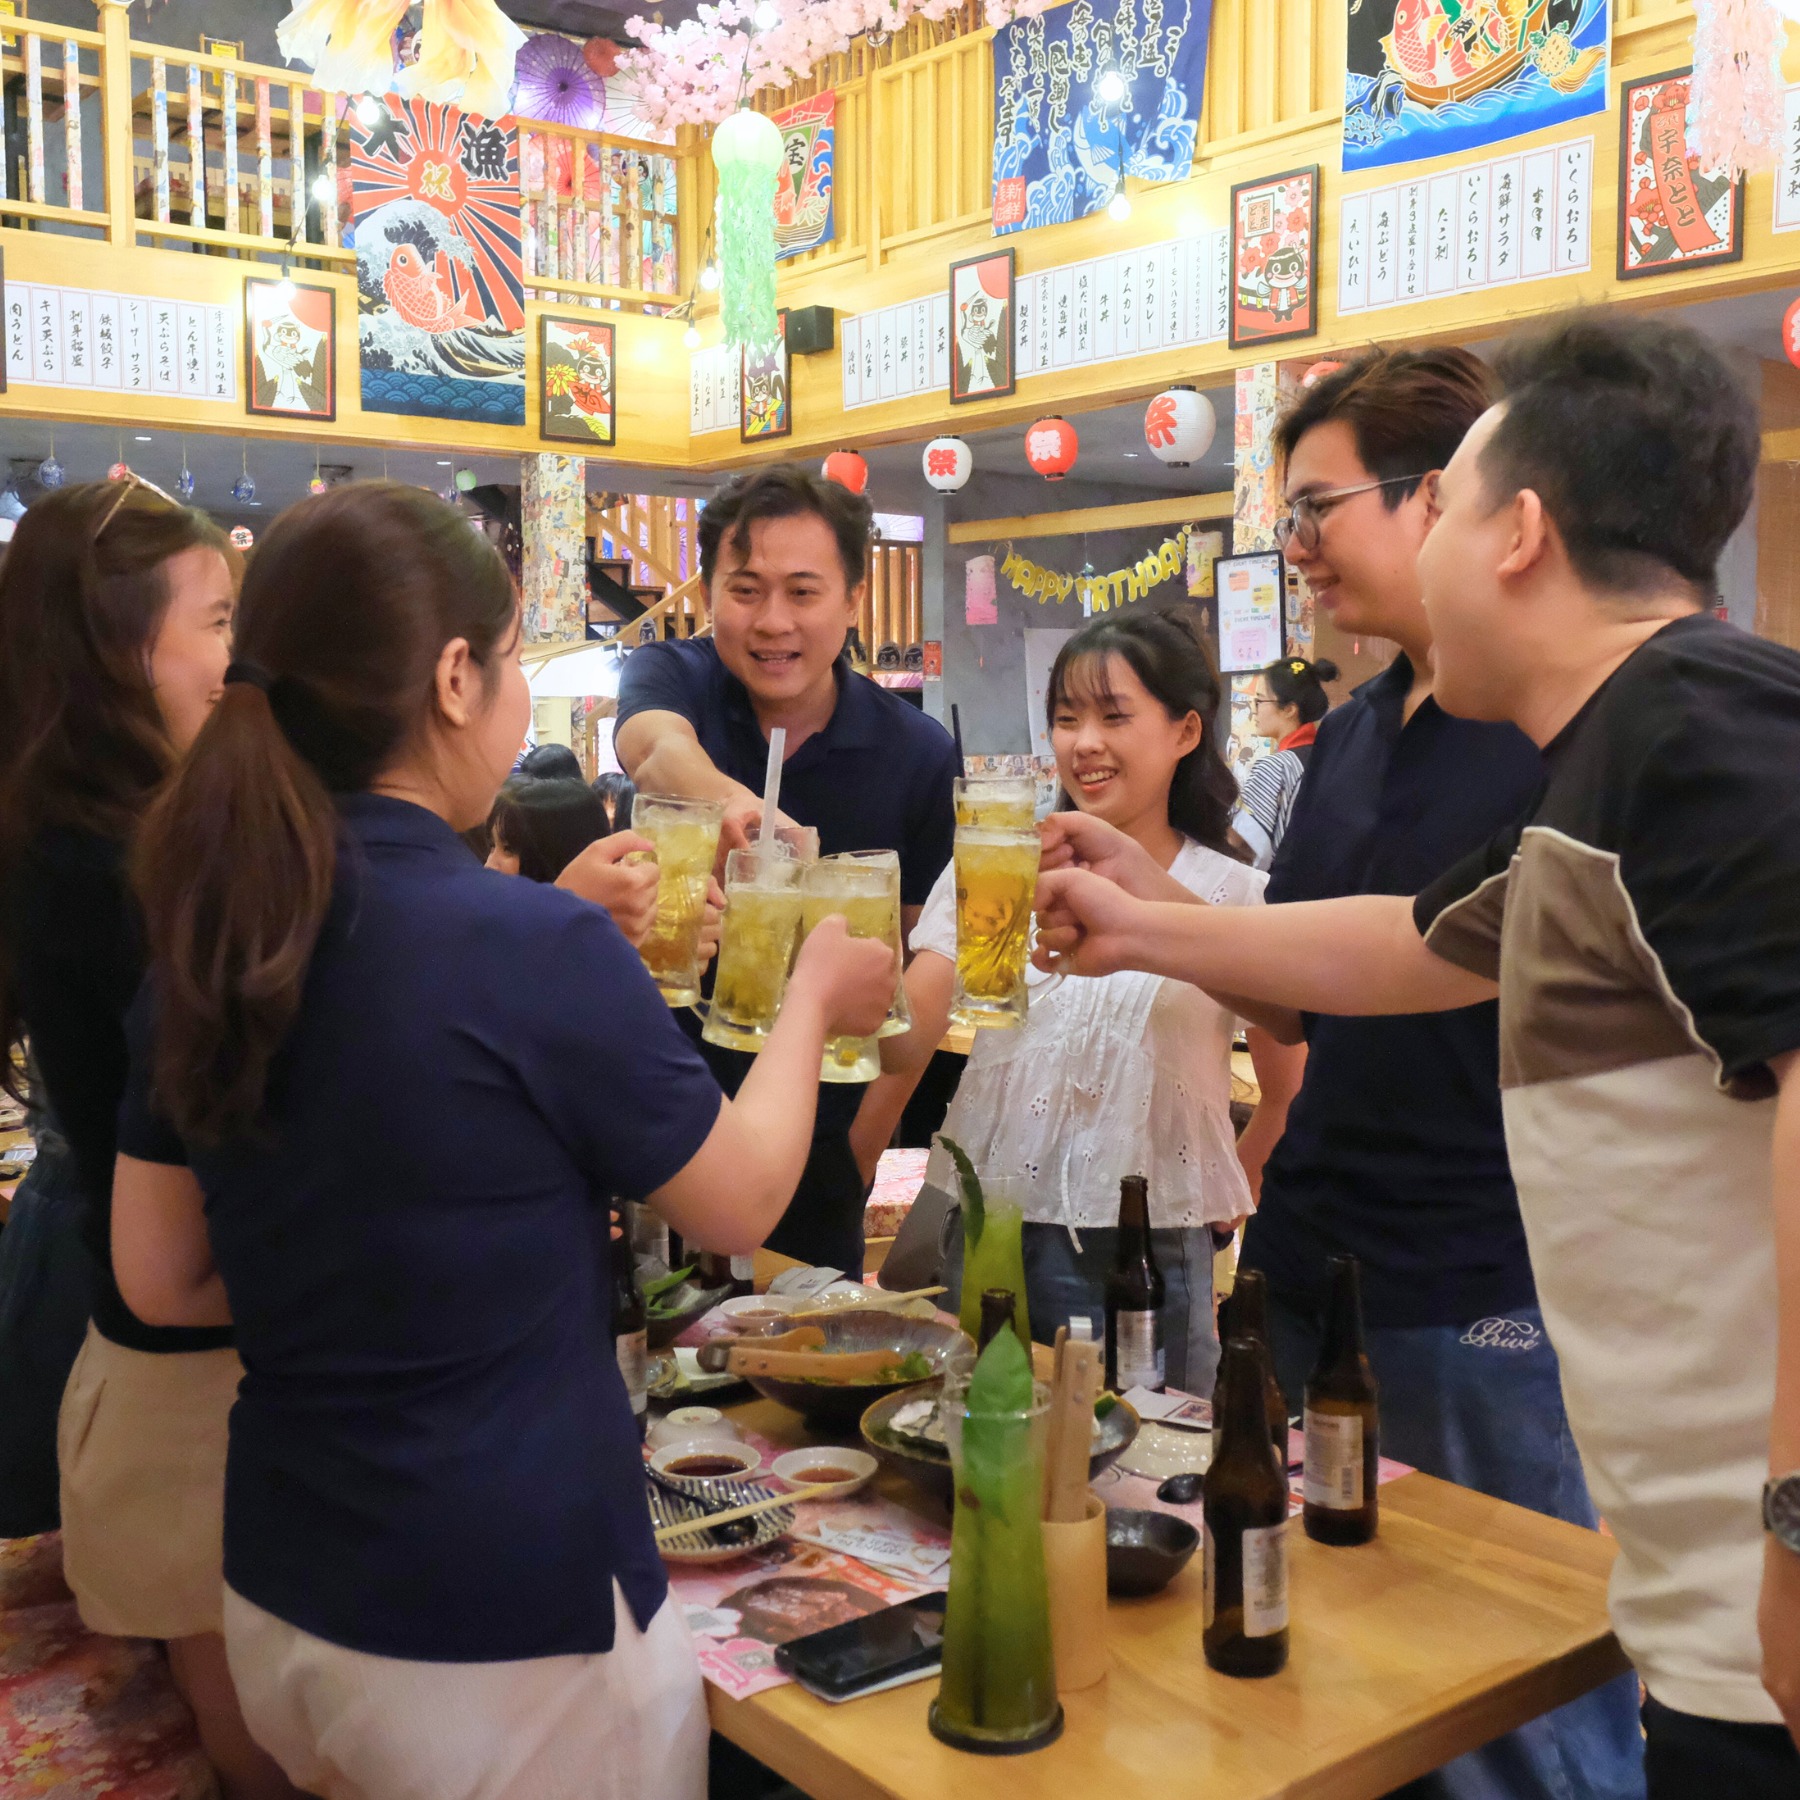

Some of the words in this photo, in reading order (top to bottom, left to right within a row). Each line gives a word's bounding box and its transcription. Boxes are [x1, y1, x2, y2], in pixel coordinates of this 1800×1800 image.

[419, 160, 456, 201] 祝
[785, 138, 806, 166] 宝
[1657, 128, 1697, 229] 宇奈とと
[1434, 207, 1449, 261] たこ刺
[1466, 174, 1481, 281] いくらおろし
[1497, 172, 1512, 267] 海鮮サラダ
[1565, 150, 1582, 263] いくらおろし
[1348, 218, 1359, 286] えいひれ
[1376, 210, 1390, 281] 海ぶどう
[9, 302, 24, 361] 肉うどん
[1099, 293, 1110, 322] 牛丼
[1122, 266, 1132, 339] オムカレー
[1145, 261, 1156, 334] カツカレー
[40, 300, 54, 370] キス天ぷら
[158, 312, 172, 381] 天ぷらそば
[1028, 429, 1063, 463] 祭
[1146, 395, 1178, 449] 祭
[928, 448, 958, 477] 祭
[1000, 551, 1074, 605] HAPPY
